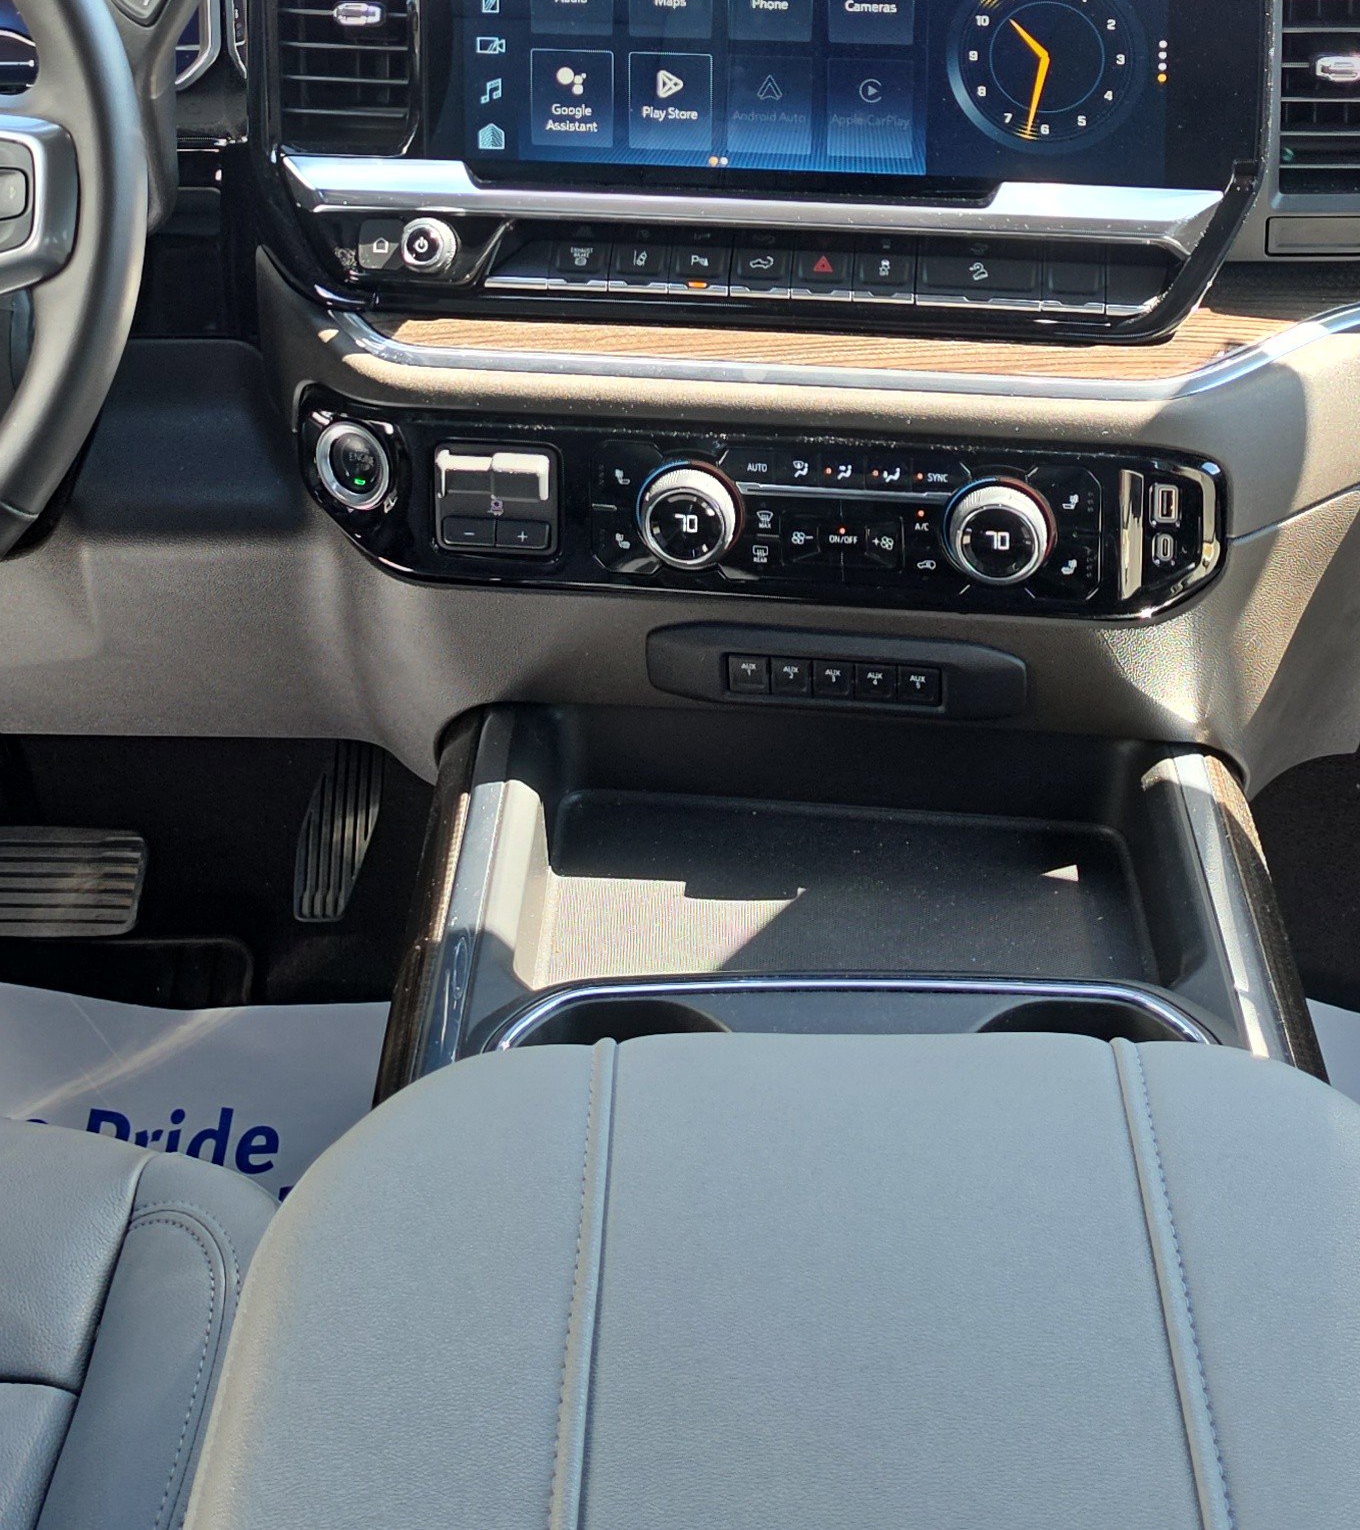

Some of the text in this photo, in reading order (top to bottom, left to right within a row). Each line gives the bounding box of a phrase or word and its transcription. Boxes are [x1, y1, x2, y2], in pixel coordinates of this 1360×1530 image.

[844, 0, 897, 13] Cameras
[975, 16, 990, 26] 10
[1106, 19, 1116, 30] 2
[968, 51, 979, 61] 9
[1116, 54, 1126, 65] 3
[977, 86, 987, 97] 8
[1104, 90, 1113, 101] 4
[551, 104, 592, 119] Google
[643, 107, 698, 122] Play Store
[733, 109, 807, 124] Android Auto
[1004, 113, 1013, 123] 7
[1077, 116, 1087, 127] 5
[545, 119, 598, 133] Assistant
[1040, 124, 1050, 135] 6
[746, 462, 768, 473] AUTO
[927, 472, 949, 483] SYNC
[675, 513, 698, 533] 70
[914, 522, 930, 532] A/C
[829, 534, 858, 545] ON/OFF
[985, 530, 1010, 551] 70
[741, 663, 757, 671] AUX
[782, 666, 799, 674] AUX
[867, 672, 883, 680] AUX
[909, 675, 926, 683] AUX
